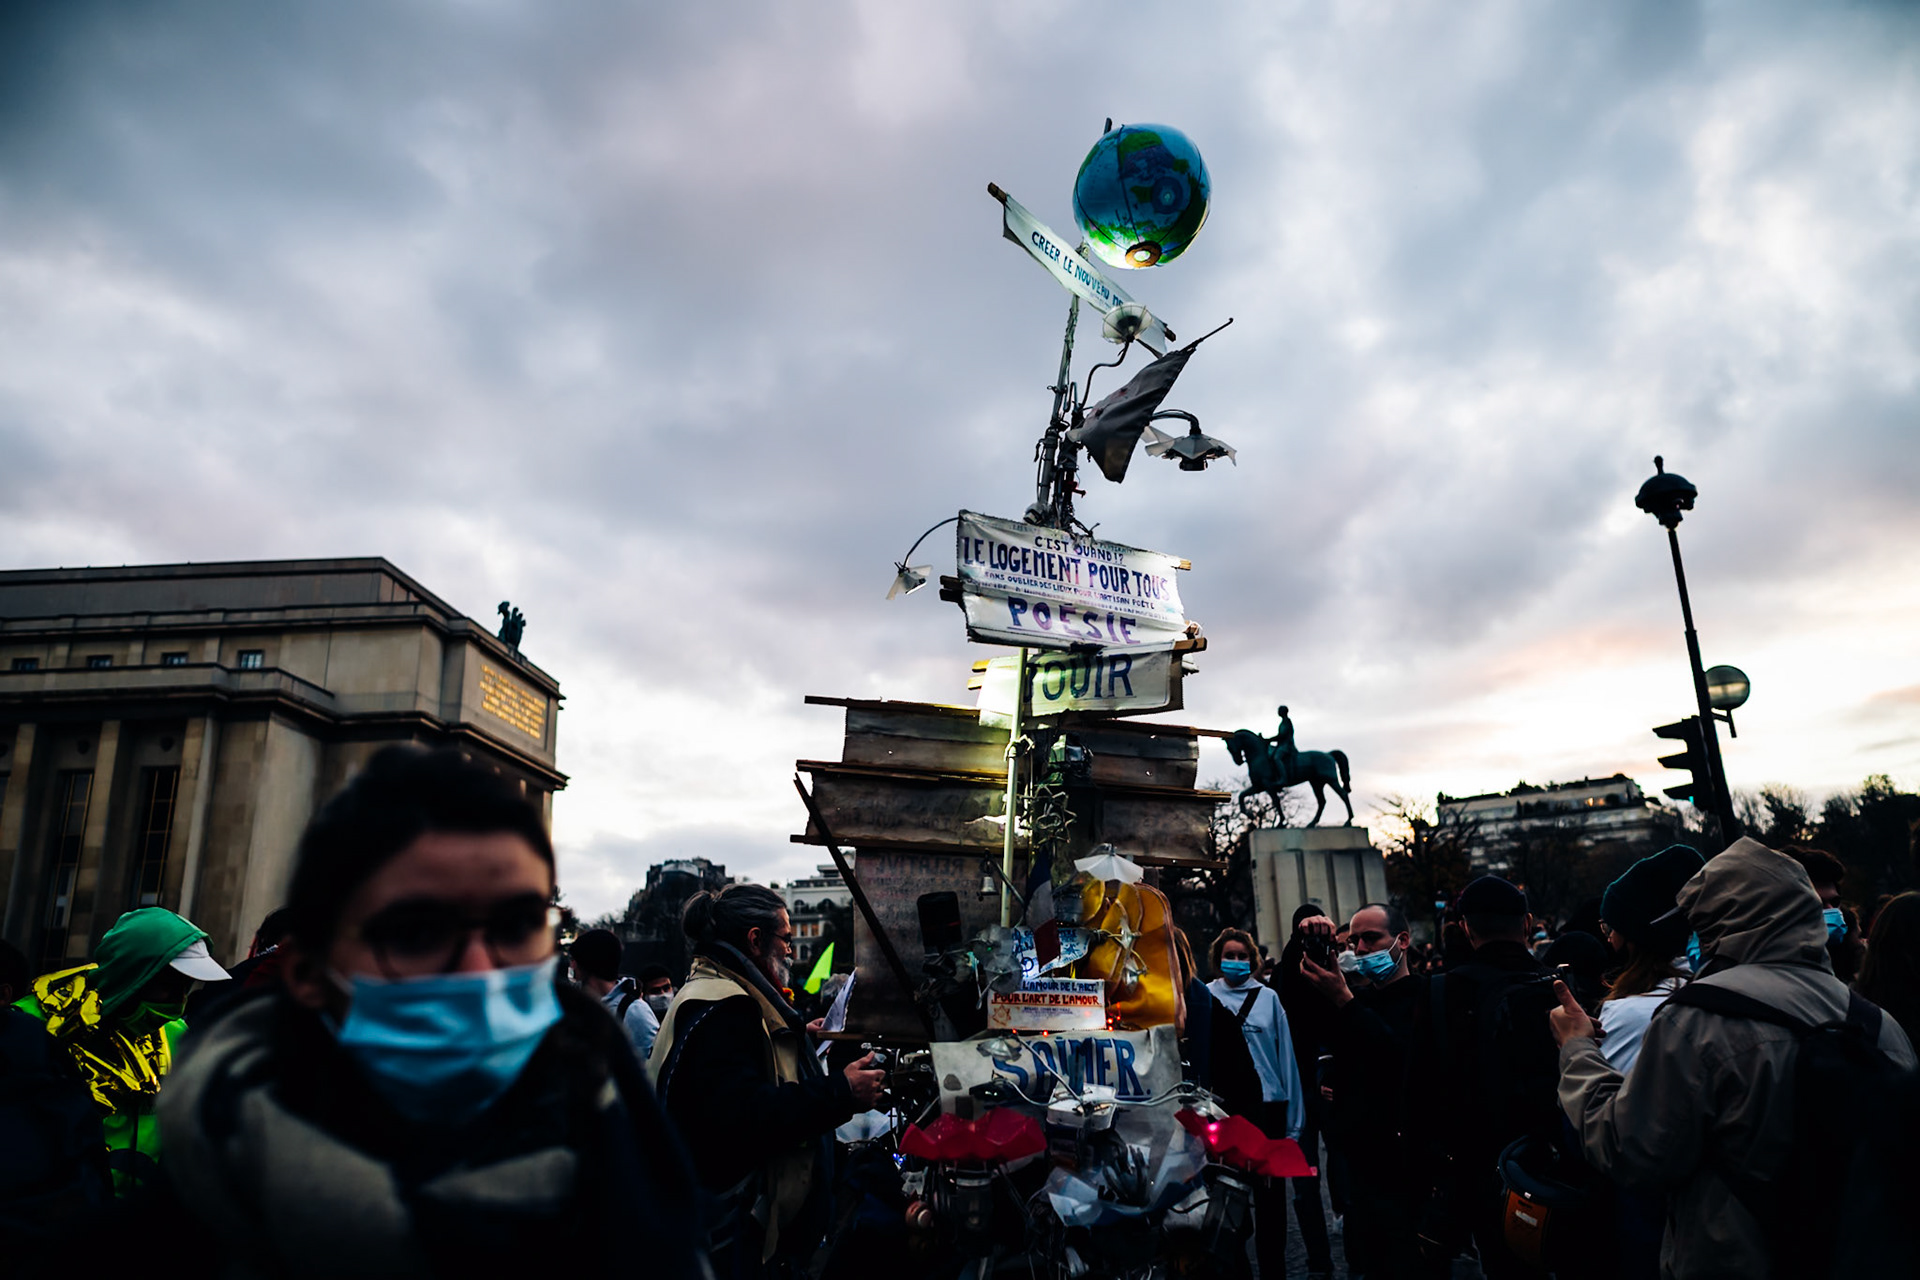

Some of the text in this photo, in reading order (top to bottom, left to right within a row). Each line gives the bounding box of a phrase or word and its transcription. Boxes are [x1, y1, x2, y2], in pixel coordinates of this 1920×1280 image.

[1032, 231, 1061, 263] CREER
[1063, 255, 1074, 274] LE
[1035, 536, 1069, 552] C'EST
[963, 537, 985, 565] LE
[989, 541, 1081, 586] LOGEMENT
[1087, 560, 1131, 595] POUR
[1132, 570, 1170, 601] TOUS
[985, 571, 1005, 581] SANS
[1007, 576, 1039, 588] OUBLIER
[1039, 581, 1053, 590] DES
[1022, 980, 1059, 992] L'AMOUR
[1060, 982, 1071, 991] DE
[993, 992, 1100, 1006] POUR L'ART DE L'AMOUR
